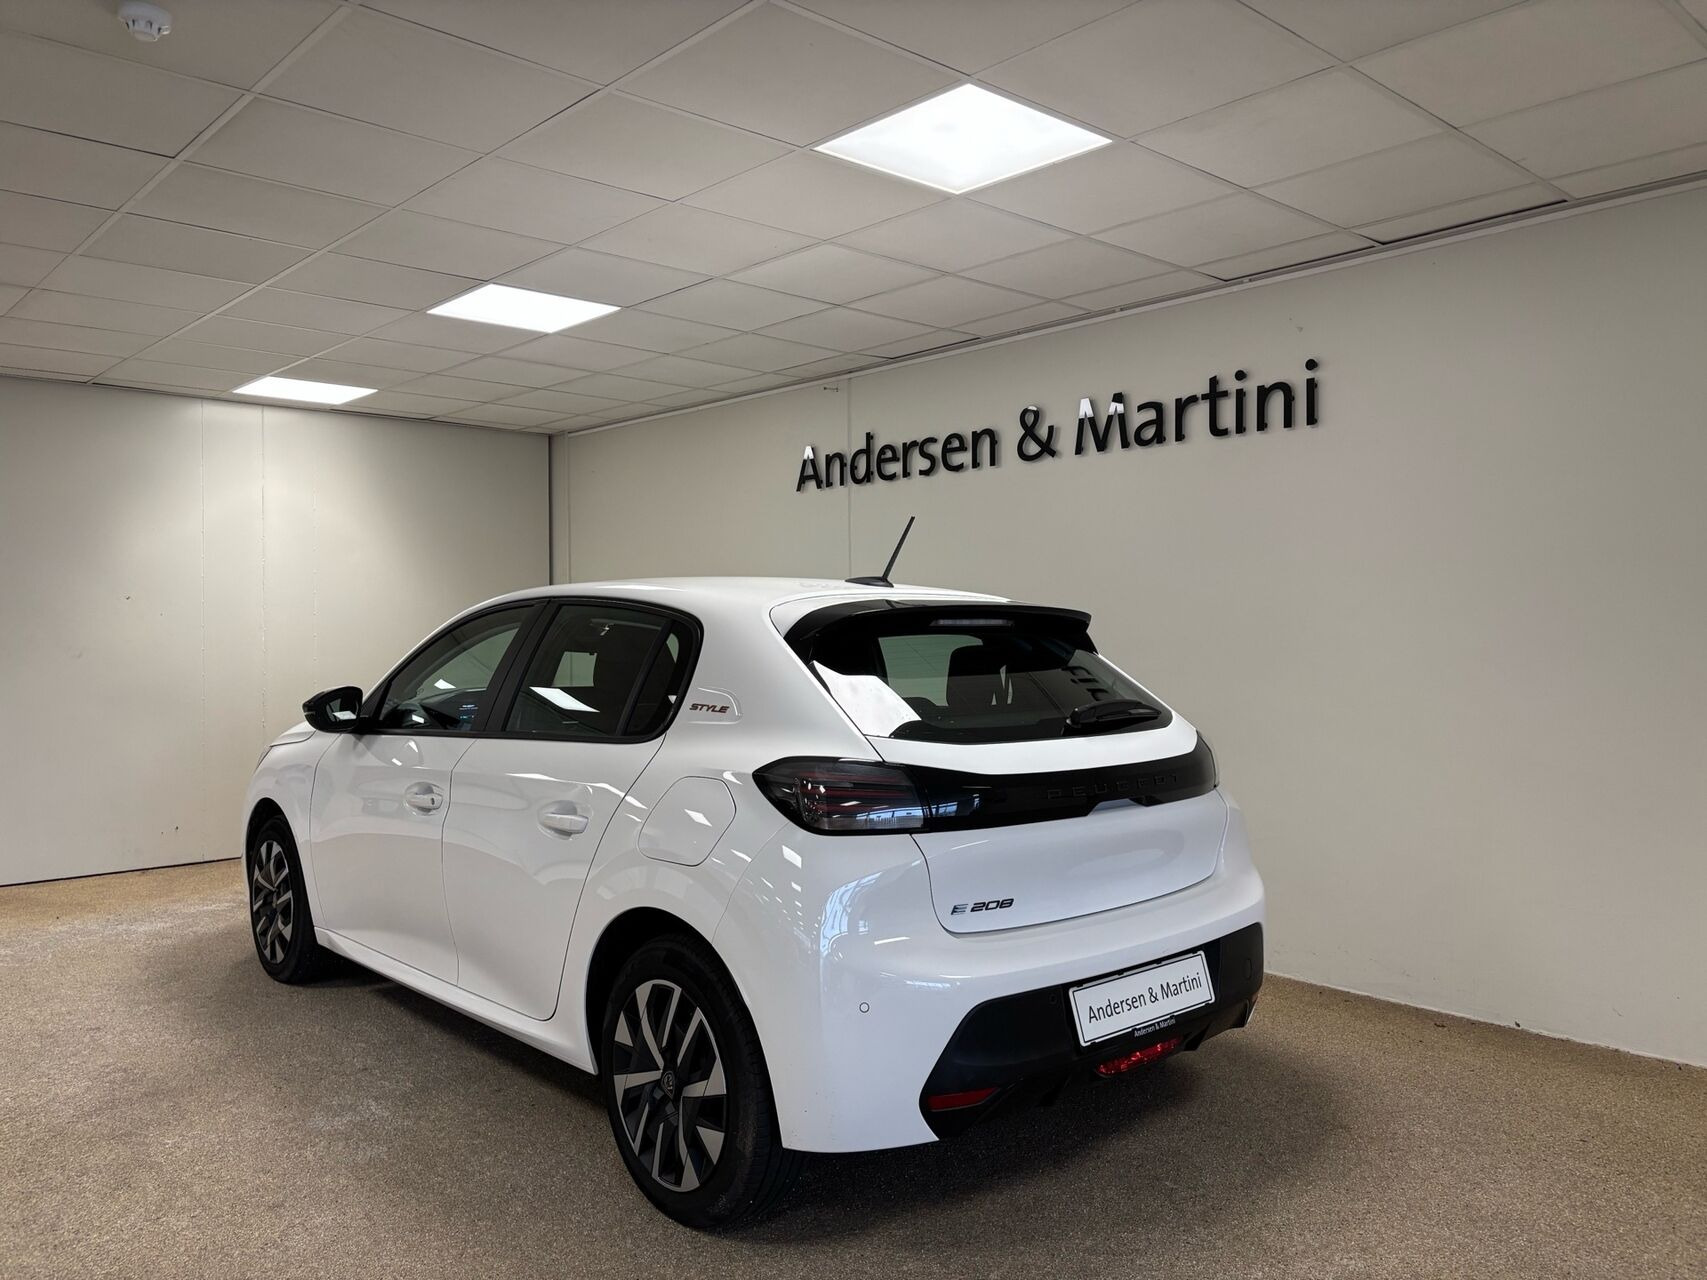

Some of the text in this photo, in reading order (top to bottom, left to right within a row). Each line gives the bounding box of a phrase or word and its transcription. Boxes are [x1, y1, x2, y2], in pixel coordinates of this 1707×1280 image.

[796, 357, 1320, 493] Andersen & Martini
[689, 703, 730, 713] STYLE
[1047, 773, 1178, 800] PEUGEOT
[950, 898, 1015, 916] E 208
[1088, 972, 1202, 1024] Andersen & Martini
[1134, 1025, 1155, 1038] Andersen
[1159, 1017, 1176, 1028] Martini
